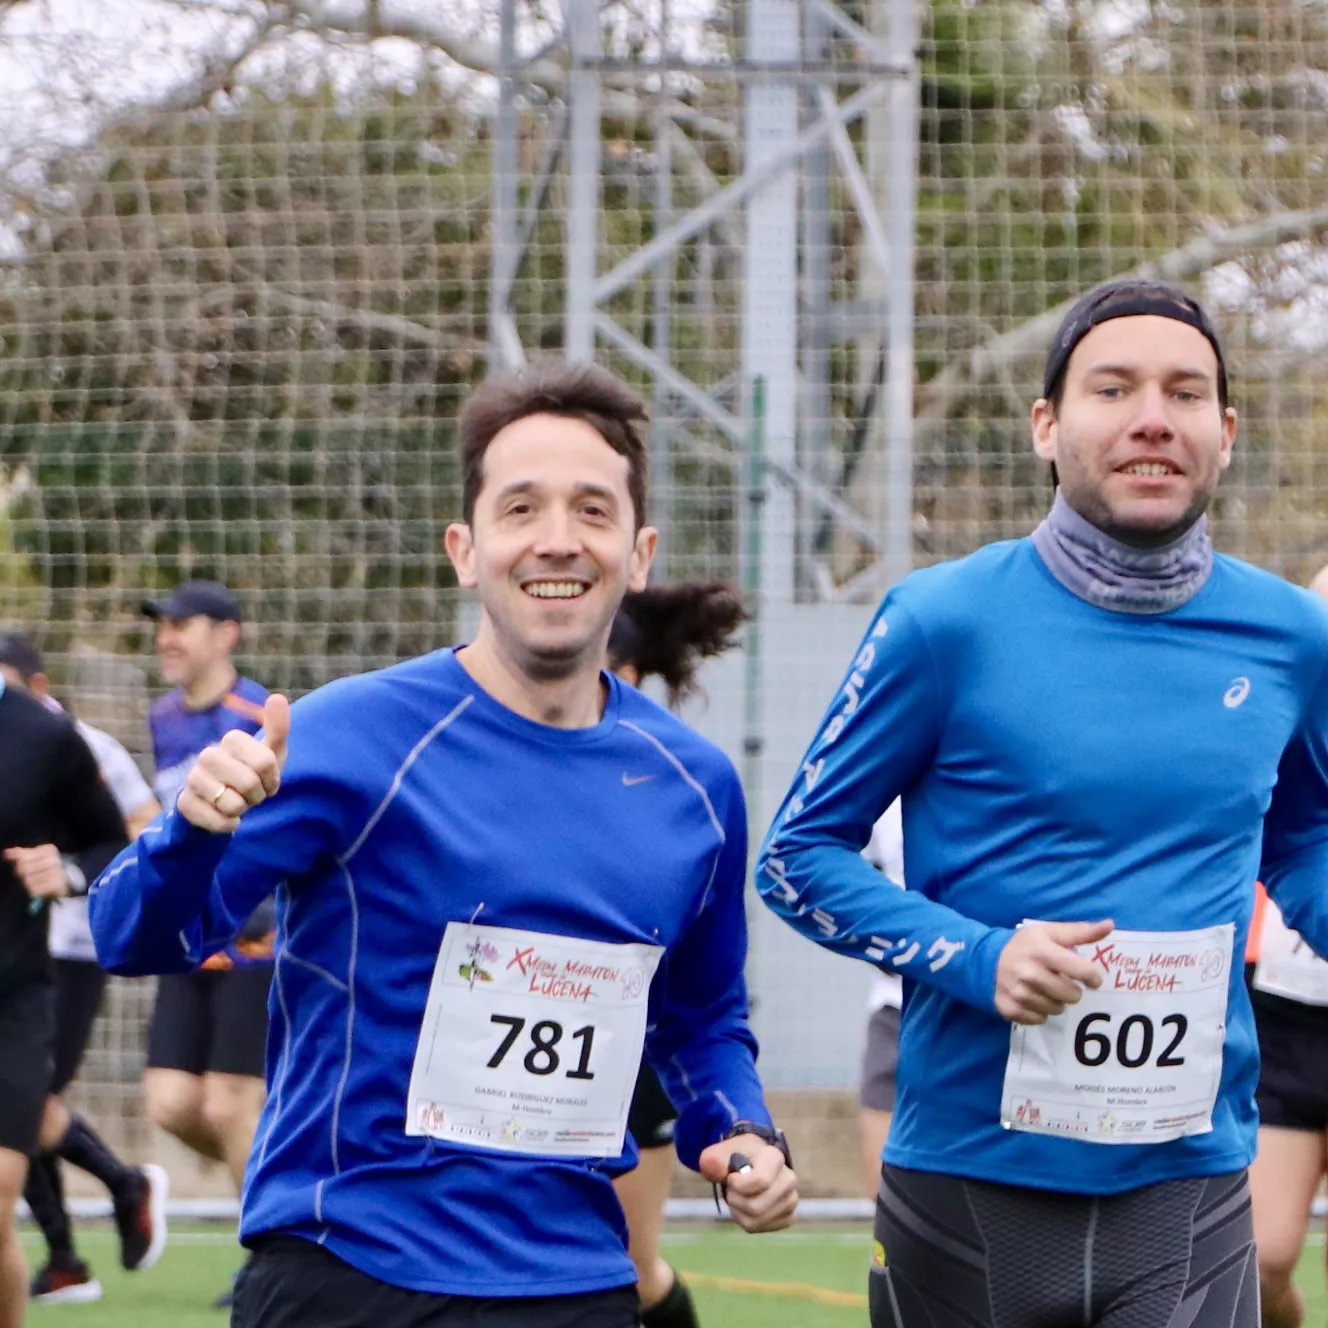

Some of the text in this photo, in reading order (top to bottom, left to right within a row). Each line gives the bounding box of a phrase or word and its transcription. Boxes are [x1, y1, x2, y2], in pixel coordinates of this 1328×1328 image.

[528, 972, 599, 1003] LUCENA
[1113, 970, 1182, 994] LUCENA
[485, 1012, 596, 1081] 781
[1073, 1012, 1188, 1069] 602
[474, 1087, 508, 1099] GABRIEL
[1107, 1085, 1143, 1095] MORENO
